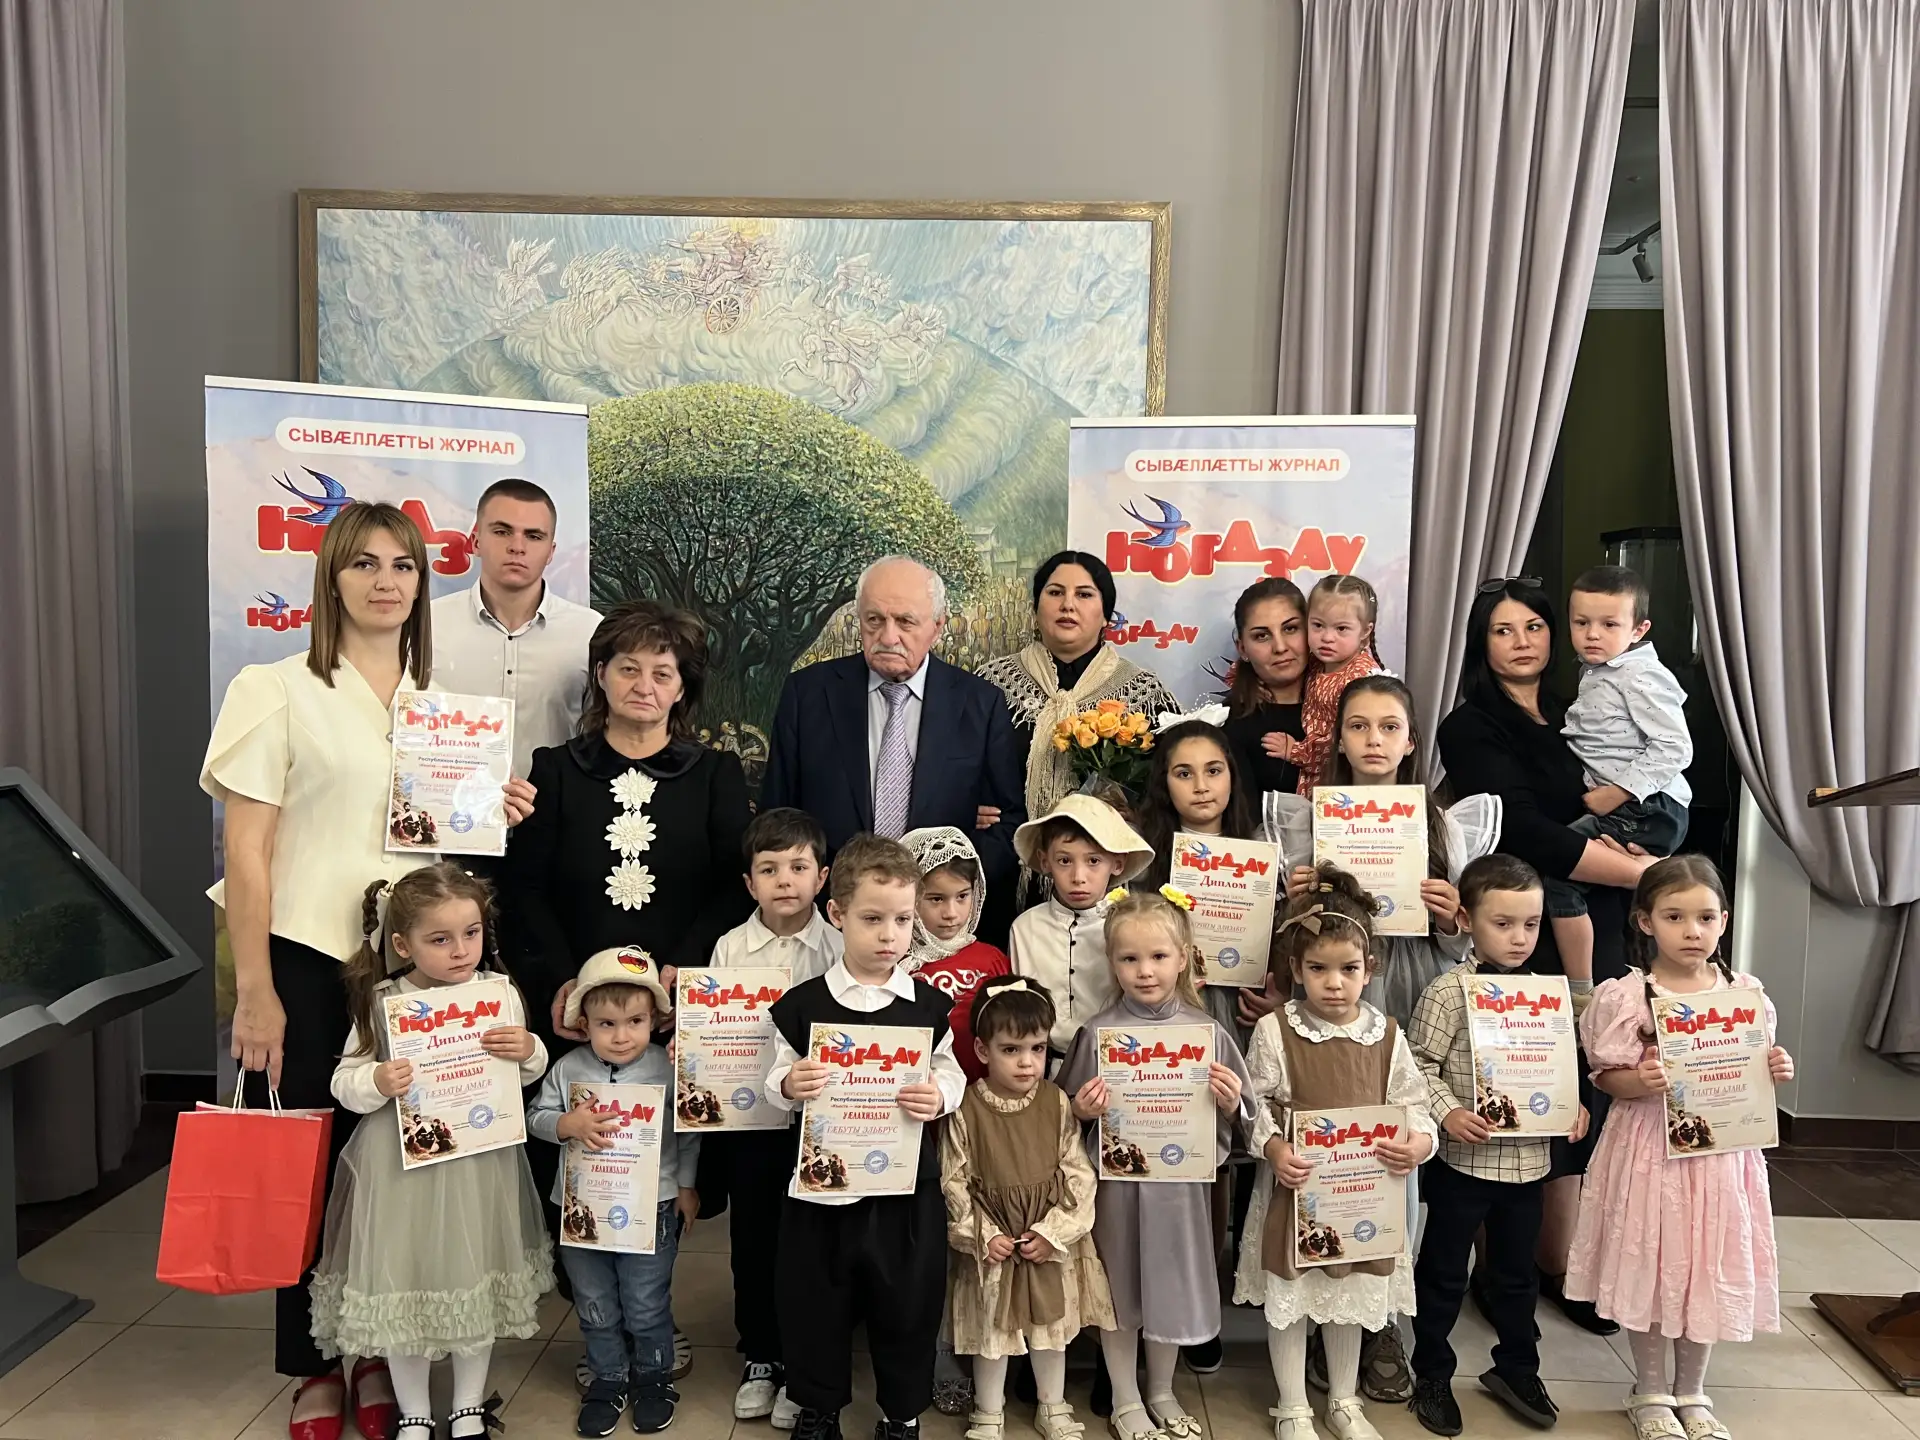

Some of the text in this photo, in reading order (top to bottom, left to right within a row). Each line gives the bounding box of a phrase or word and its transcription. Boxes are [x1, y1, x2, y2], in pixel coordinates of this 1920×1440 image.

[288, 427, 514, 456] СЫВÆЛЛÆТТЫ ЖУРНАЛ
[1135, 458, 1340, 472] СЫВÆЛЛÆТТЫ ЖУРНАЛ
[1105, 520, 1366, 583] НОГДЗАУ
[429, 734, 480, 748] Диплом
[1324, 800, 1416, 822] НОГДЗАУ
[1345, 824, 1394, 835] Диплом
[1181, 852, 1270, 878] НОГДЗАУ
[1200, 875, 1247, 889] Диплом
[688, 984, 783, 1010] НОГДЗАУ
[1476, 991, 1561, 1016] НОГДЗАУ
[399, 1000, 502, 1033] НОГДЗАУ
[710, 1012, 760, 1025] Диплом
[1500, 1017, 1545, 1029] Диплом
[1665, 1007, 1756, 1034] НОГДЗАУ
[427, 1031, 481, 1049] Диплом
[1692, 1037, 1739, 1050] Диплом
[820, 1043, 921, 1071] НОГДЗАУ
[1109, 1042, 1205, 1068] НОГДЗАУ
[841, 1072, 895, 1085] Диплом
[1132, 1070, 1183, 1082] Диплом
[1305, 1123, 1399, 1148] НОГДЗАУ
[1328, 1150, 1376, 1164] Диплом
